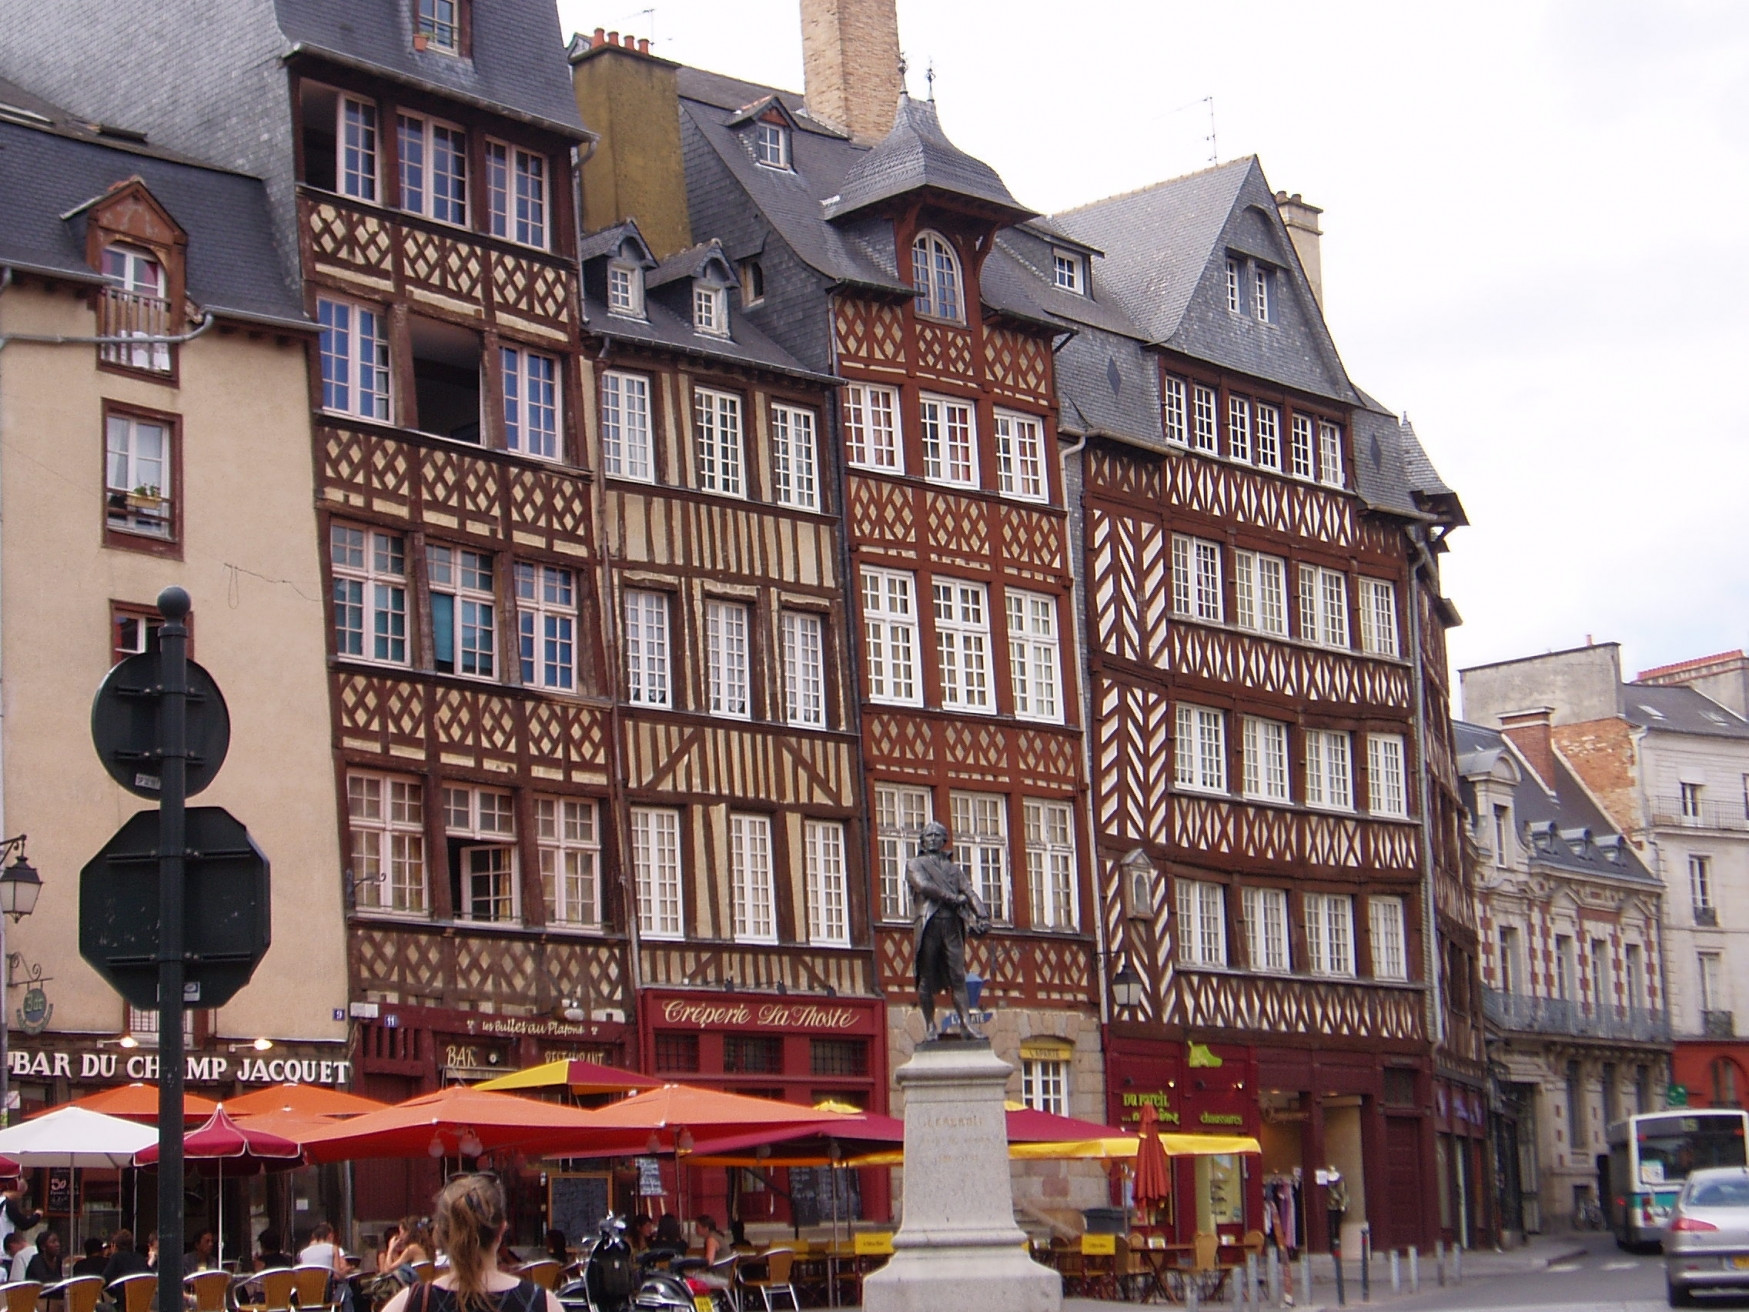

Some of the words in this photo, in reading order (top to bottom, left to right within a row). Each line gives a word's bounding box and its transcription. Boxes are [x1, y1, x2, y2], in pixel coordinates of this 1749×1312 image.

[757, 1003, 791, 1026] La
[494, 1018, 526, 1035] Bulles
[527, 1022, 545, 1035] au
[546, 1021, 585, 1037] Plafond
[12, 1051, 72, 1079] BAR
[81, 1053, 118, 1078] DU
[126, 1055, 227, 1080] CHMP
[236, 1058, 349, 1084] JACQUET
[446, 1044, 477, 1068] BAR
